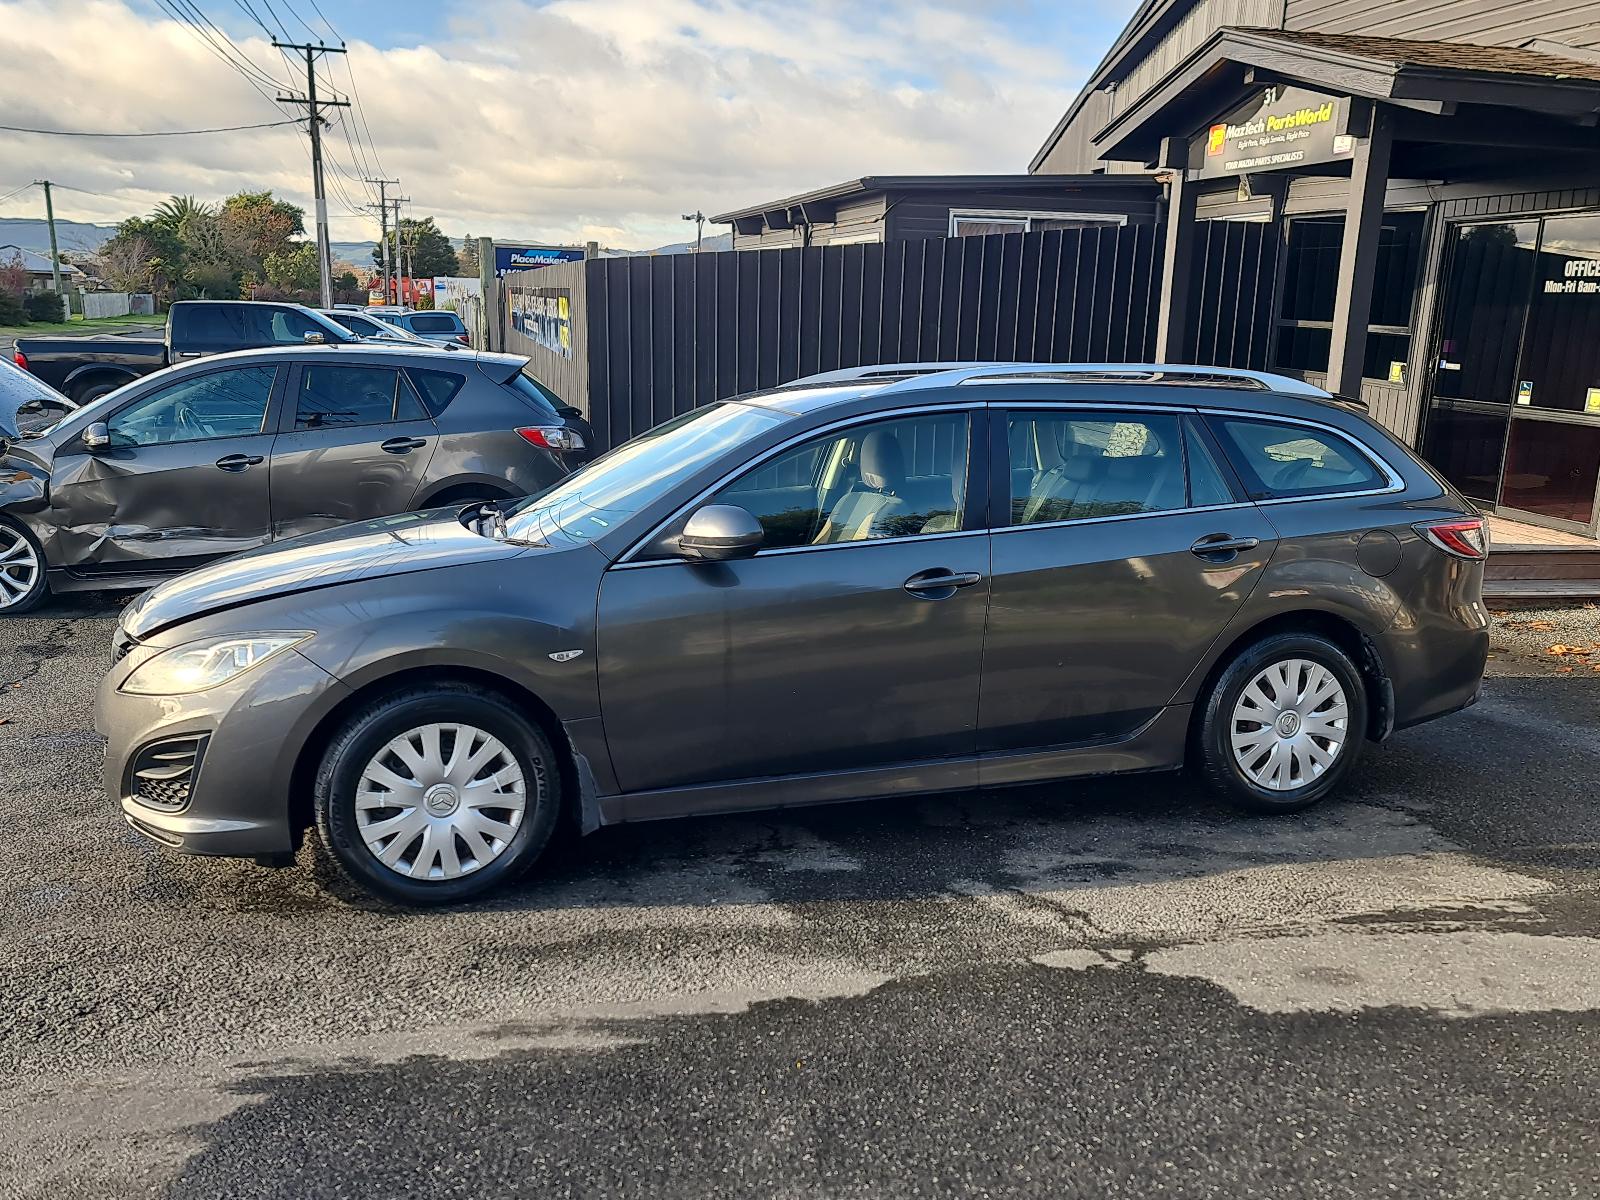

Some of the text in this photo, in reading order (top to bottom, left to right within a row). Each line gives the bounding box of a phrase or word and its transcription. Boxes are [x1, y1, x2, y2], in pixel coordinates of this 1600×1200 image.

[1264, 87, 1276, 104] 31
[1226, 101, 1334, 139] MazTech PartsWorld
[1254, 155, 1271, 166] PARTS
[1271, 151, 1304, 164] SPECIALISTS
[511, 254, 568, 265] PlaceMakers
[1564, 260, 1600, 277] OFFICE
[1544, 280, 1600, 293] Mon-Fri 8am-
